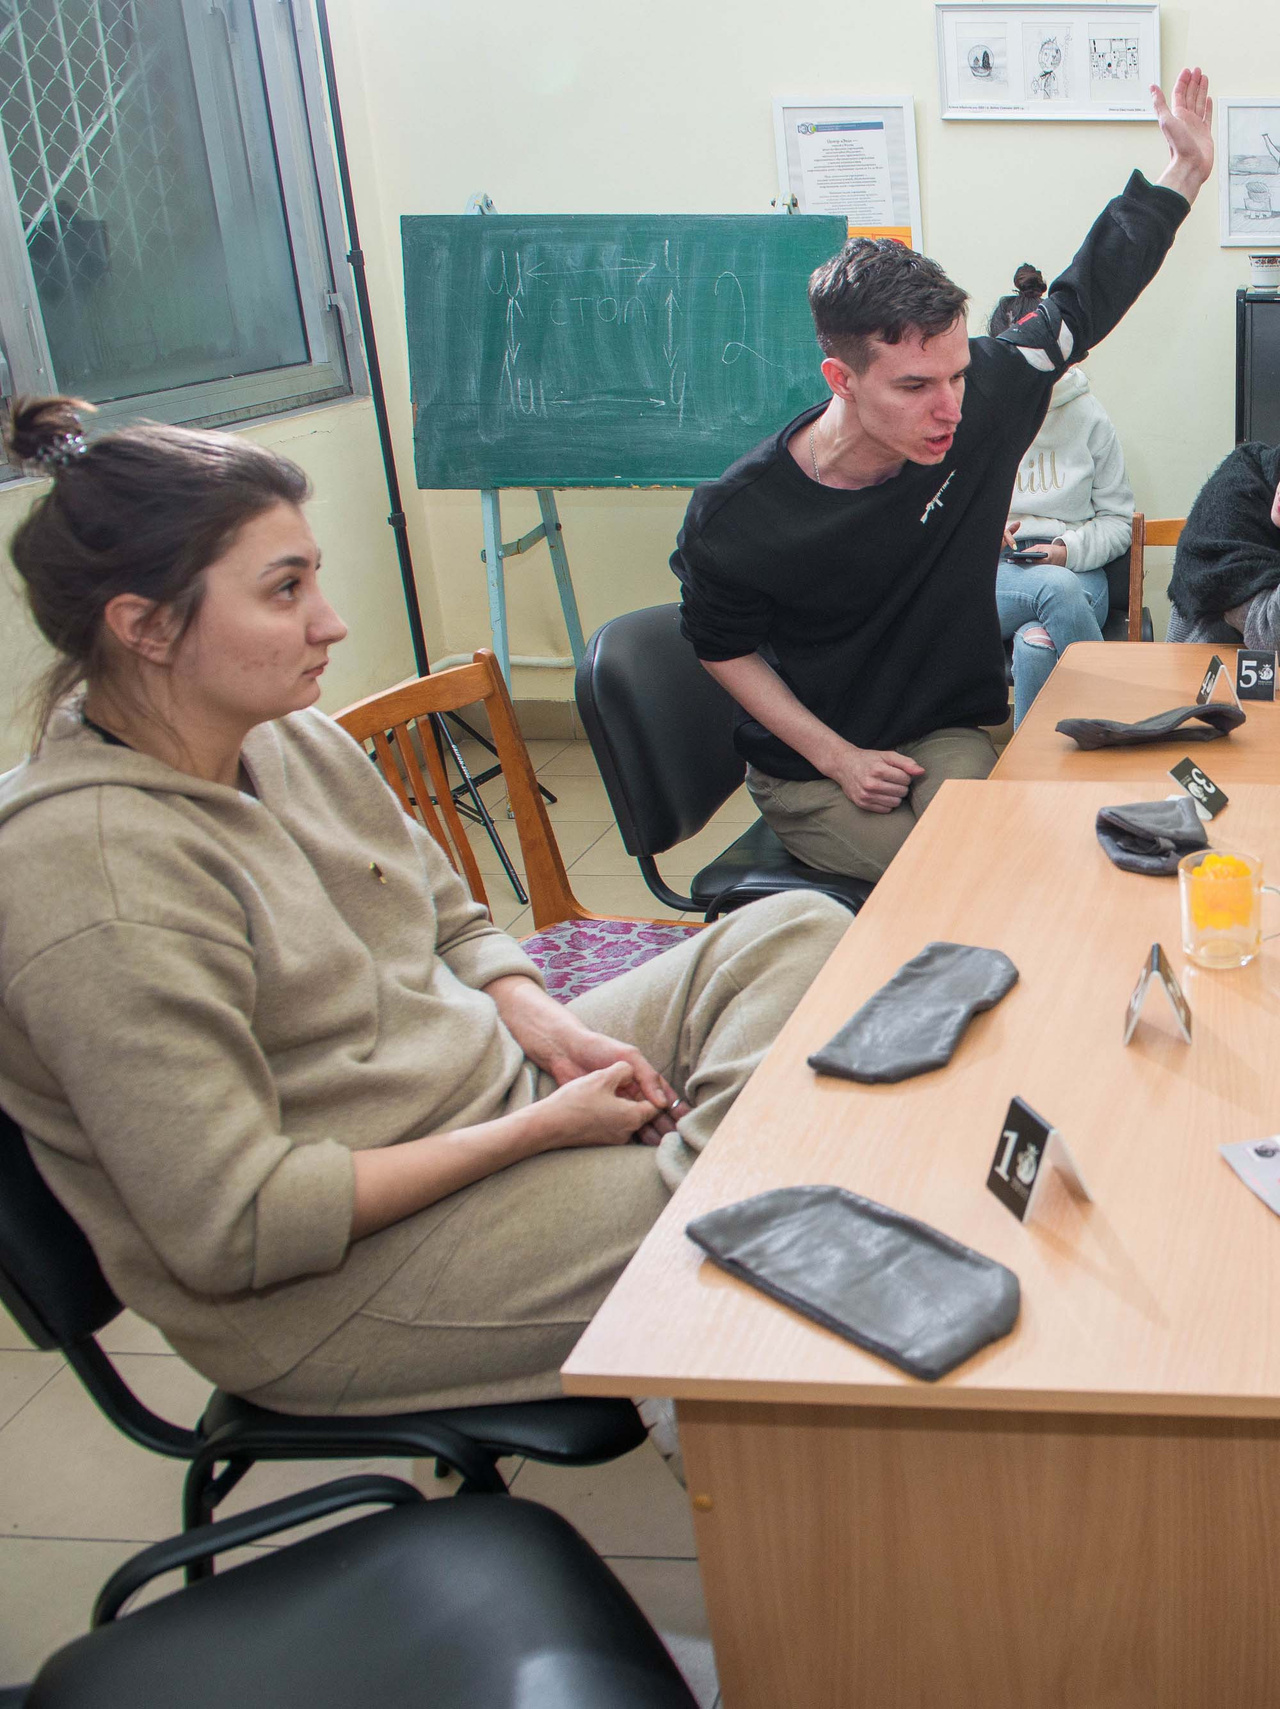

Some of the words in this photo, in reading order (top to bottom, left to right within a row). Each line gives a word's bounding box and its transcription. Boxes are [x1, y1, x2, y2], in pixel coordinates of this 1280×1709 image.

[1239, 660, 1258, 688] 5
[1191, 767, 1216, 794] 3
[993, 1129, 1019, 1182] 1
